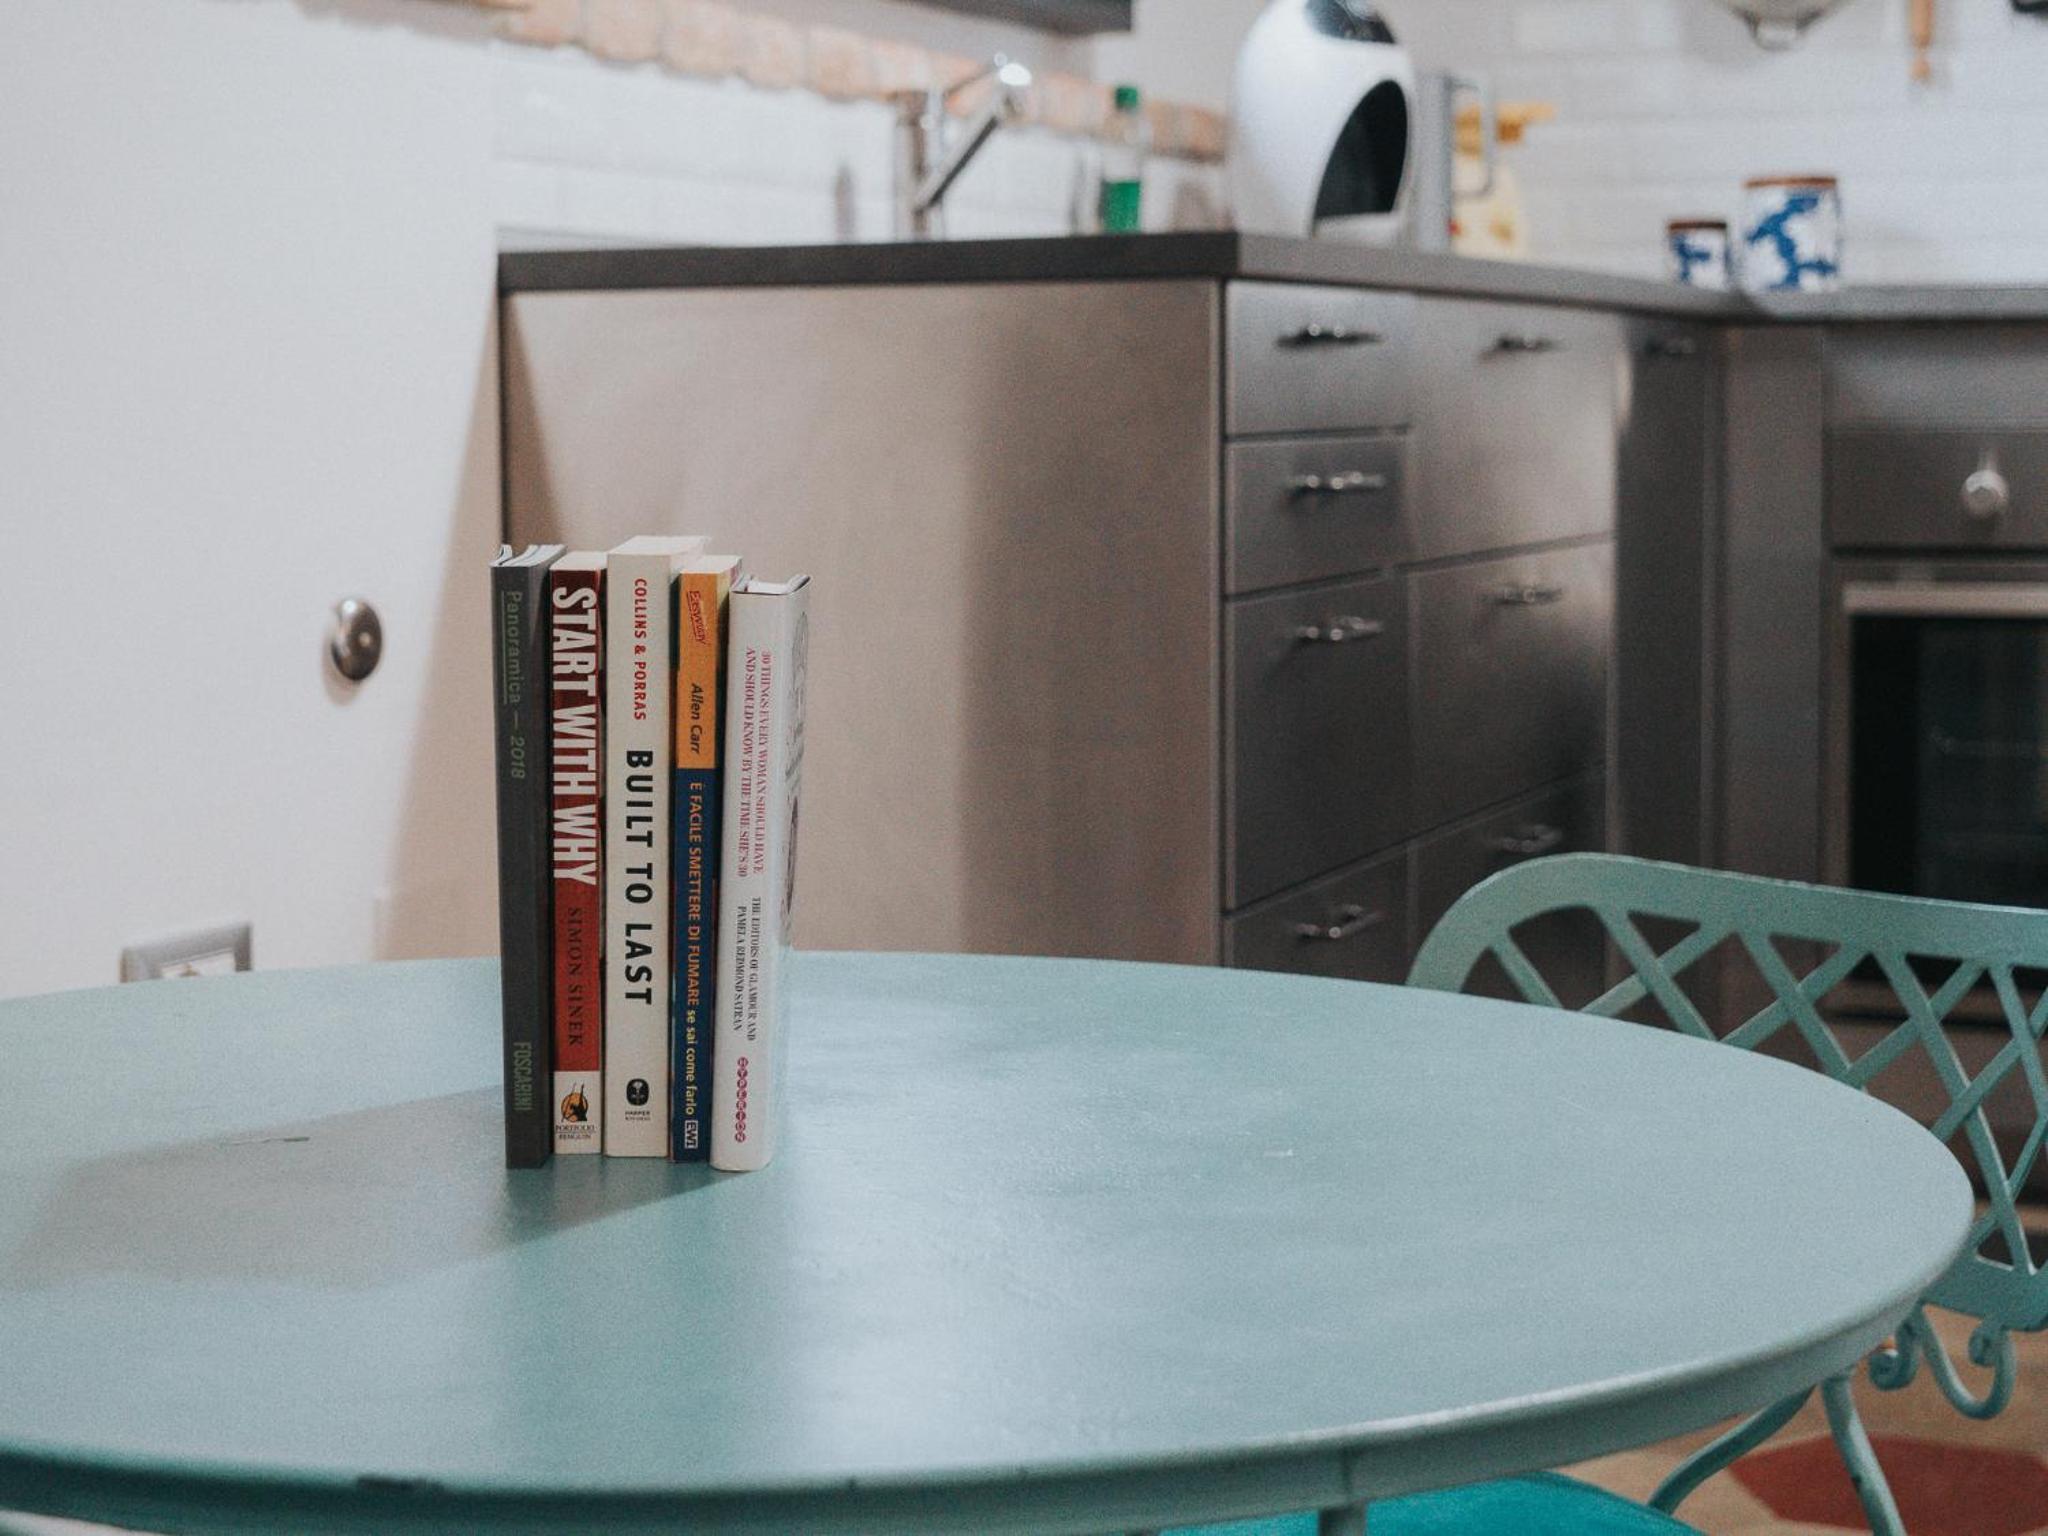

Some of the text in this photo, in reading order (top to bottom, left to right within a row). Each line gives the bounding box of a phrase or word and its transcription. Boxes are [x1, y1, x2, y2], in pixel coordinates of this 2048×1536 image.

[506, 590, 524, 703] Panoramica
[633, 578, 647, 720] COLLINS & PORRAS
[745, 647, 756, 672] AND
[743, 674, 755, 719] SHOULD
[759, 666, 771, 709] THINGS
[552, 587, 598, 886] START WITH WHY
[690, 683, 704, 755] Allen Carr
[742, 721, 754, 757] KNOW
[757, 710, 770, 746] EVERY
[510, 735, 526, 779] 2018
[742, 760, 753, 772] BY
[756, 749, 768, 795] WOMAN
[741, 776, 752, 798] THE
[688, 795, 703, 844] FACILE
[739, 801, 751, 828] TIME
[754, 796, 767, 841] SHOULD
[625, 749, 654, 1005] BUILT TO LAST
[737, 864, 748, 877] 30
[752, 843, 765, 874] HAVE
[687, 847, 702, 921] SMETTERE
[687, 926, 701, 941] DI
[736, 906, 747, 944] PAMELA
[750, 917, 761, 957] EDITORS
[568, 907, 584, 1046] SIMON SINEK
[687, 945, 701, 1006] FUMARE
[747, 972, 759, 1020] GLAMOUR
[686, 1010, 697, 1024] se
[733, 993, 744, 1031] SATRAN
[686, 1027, 698, 1044] sai
[513, 1041, 533, 1111] FOSCARINI
[685, 1048, 697, 1082] come
[685, 1086, 698, 1115] farlo
